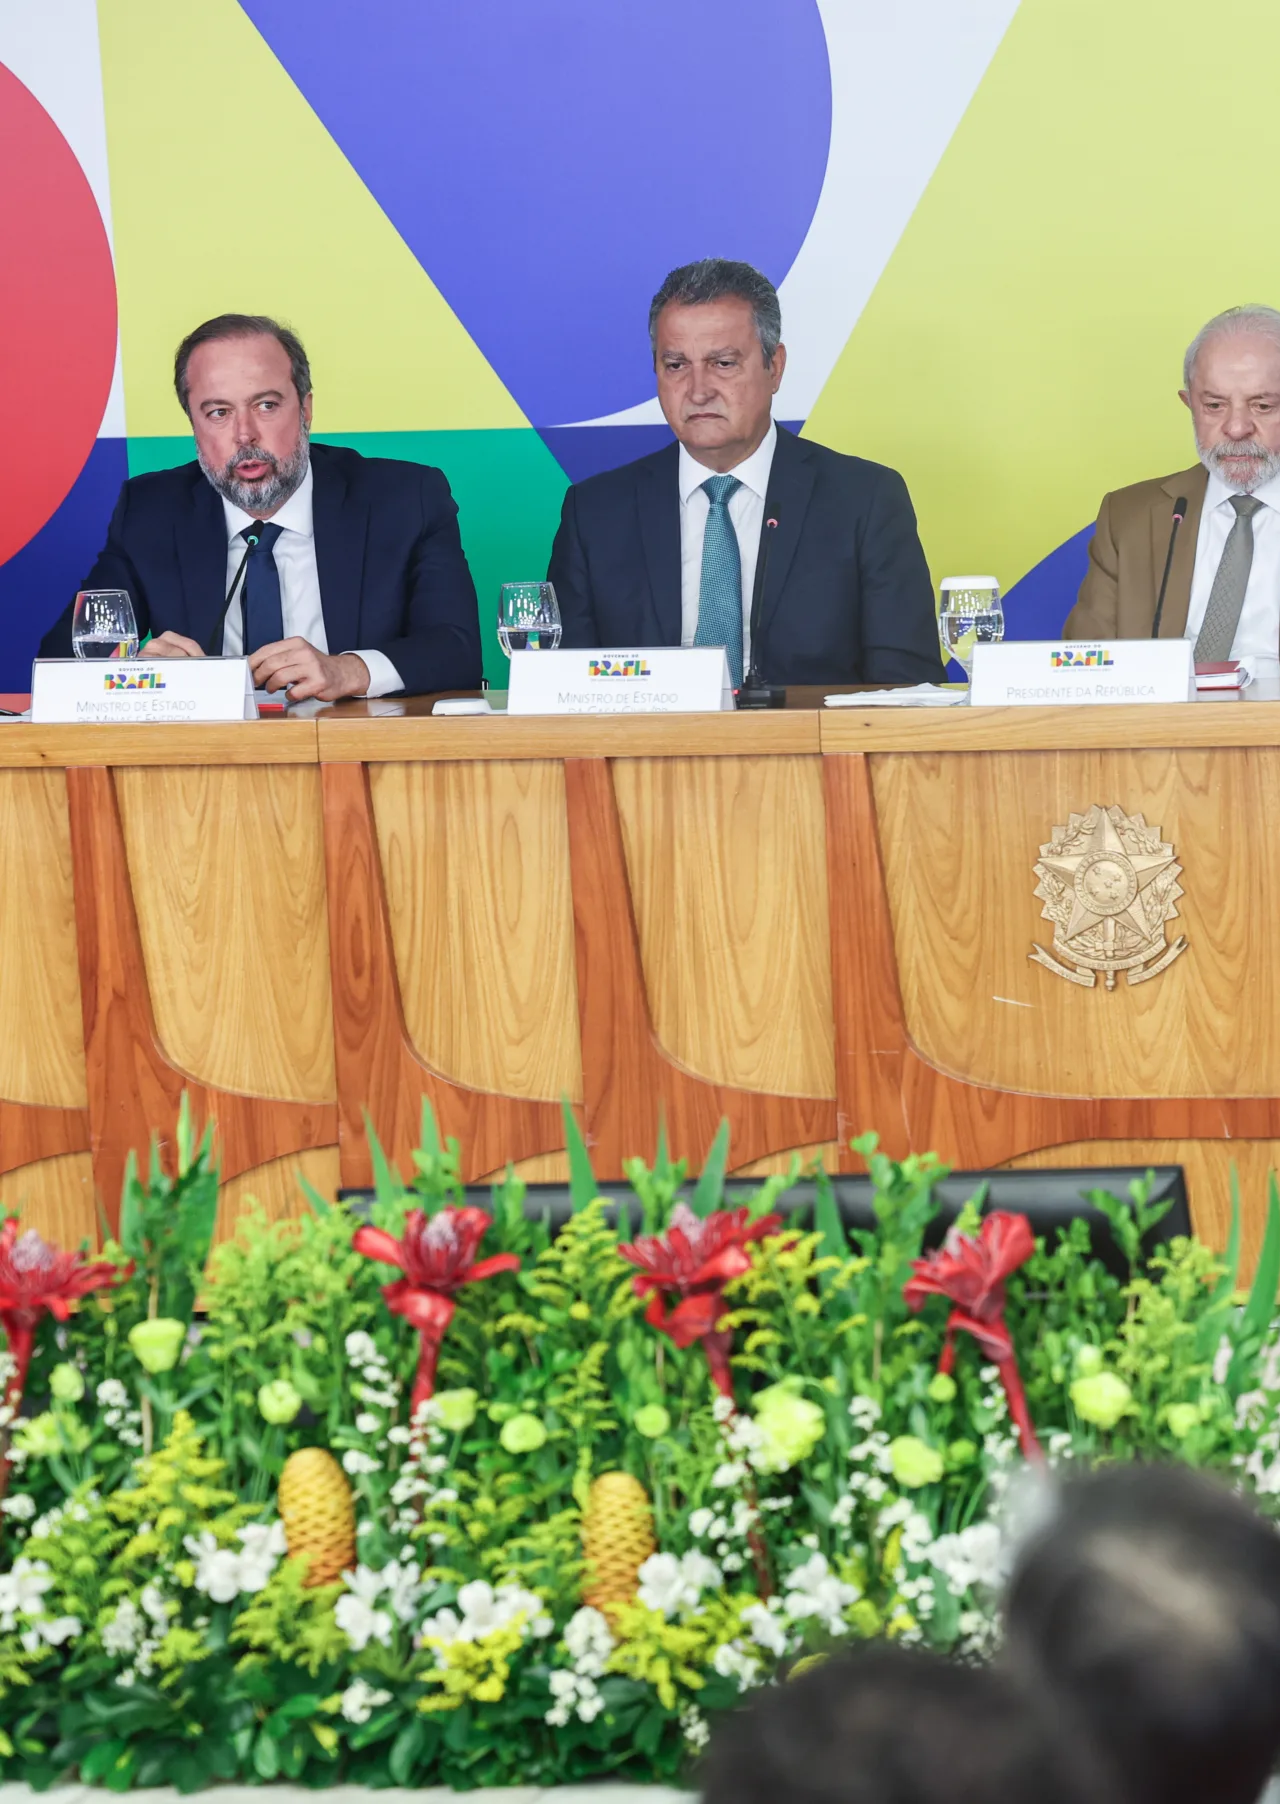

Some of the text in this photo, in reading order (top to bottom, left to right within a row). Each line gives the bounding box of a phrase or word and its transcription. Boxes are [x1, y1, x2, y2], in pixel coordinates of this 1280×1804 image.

[1050, 650, 1114, 667] BRASIL
[588, 660, 651, 676] BRASIL
[104, 672, 166, 690] BRASIL
[557, 690, 679, 704] MINISTRO DE ESTADO
[1006, 683, 1156, 699] PRESIDENTE DA REPÚBLICA
[76, 698, 197, 713] MINISTRO DE ESTADO
